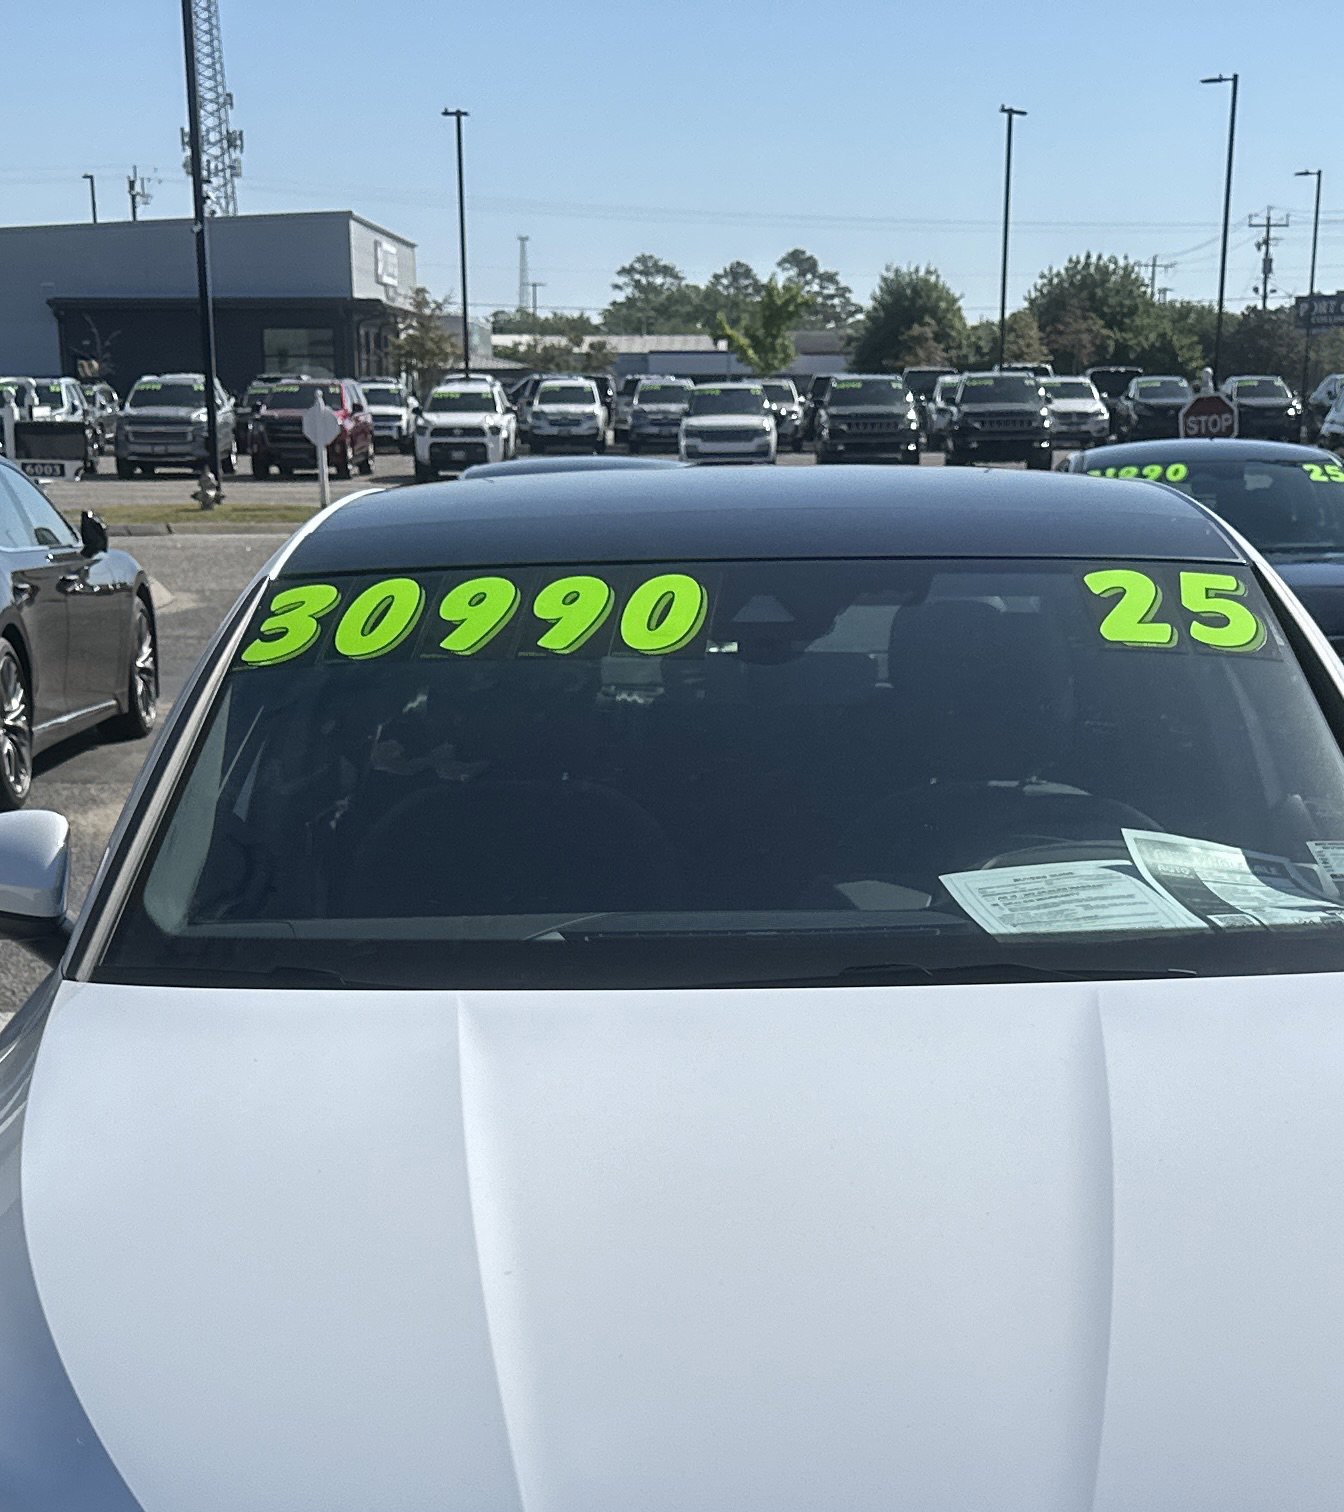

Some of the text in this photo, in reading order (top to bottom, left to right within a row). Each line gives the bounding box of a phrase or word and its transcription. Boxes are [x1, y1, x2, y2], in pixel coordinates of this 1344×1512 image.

[1185, 414, 1234, 435] STOP
[240, 569, 1268, 667] 30990 25
